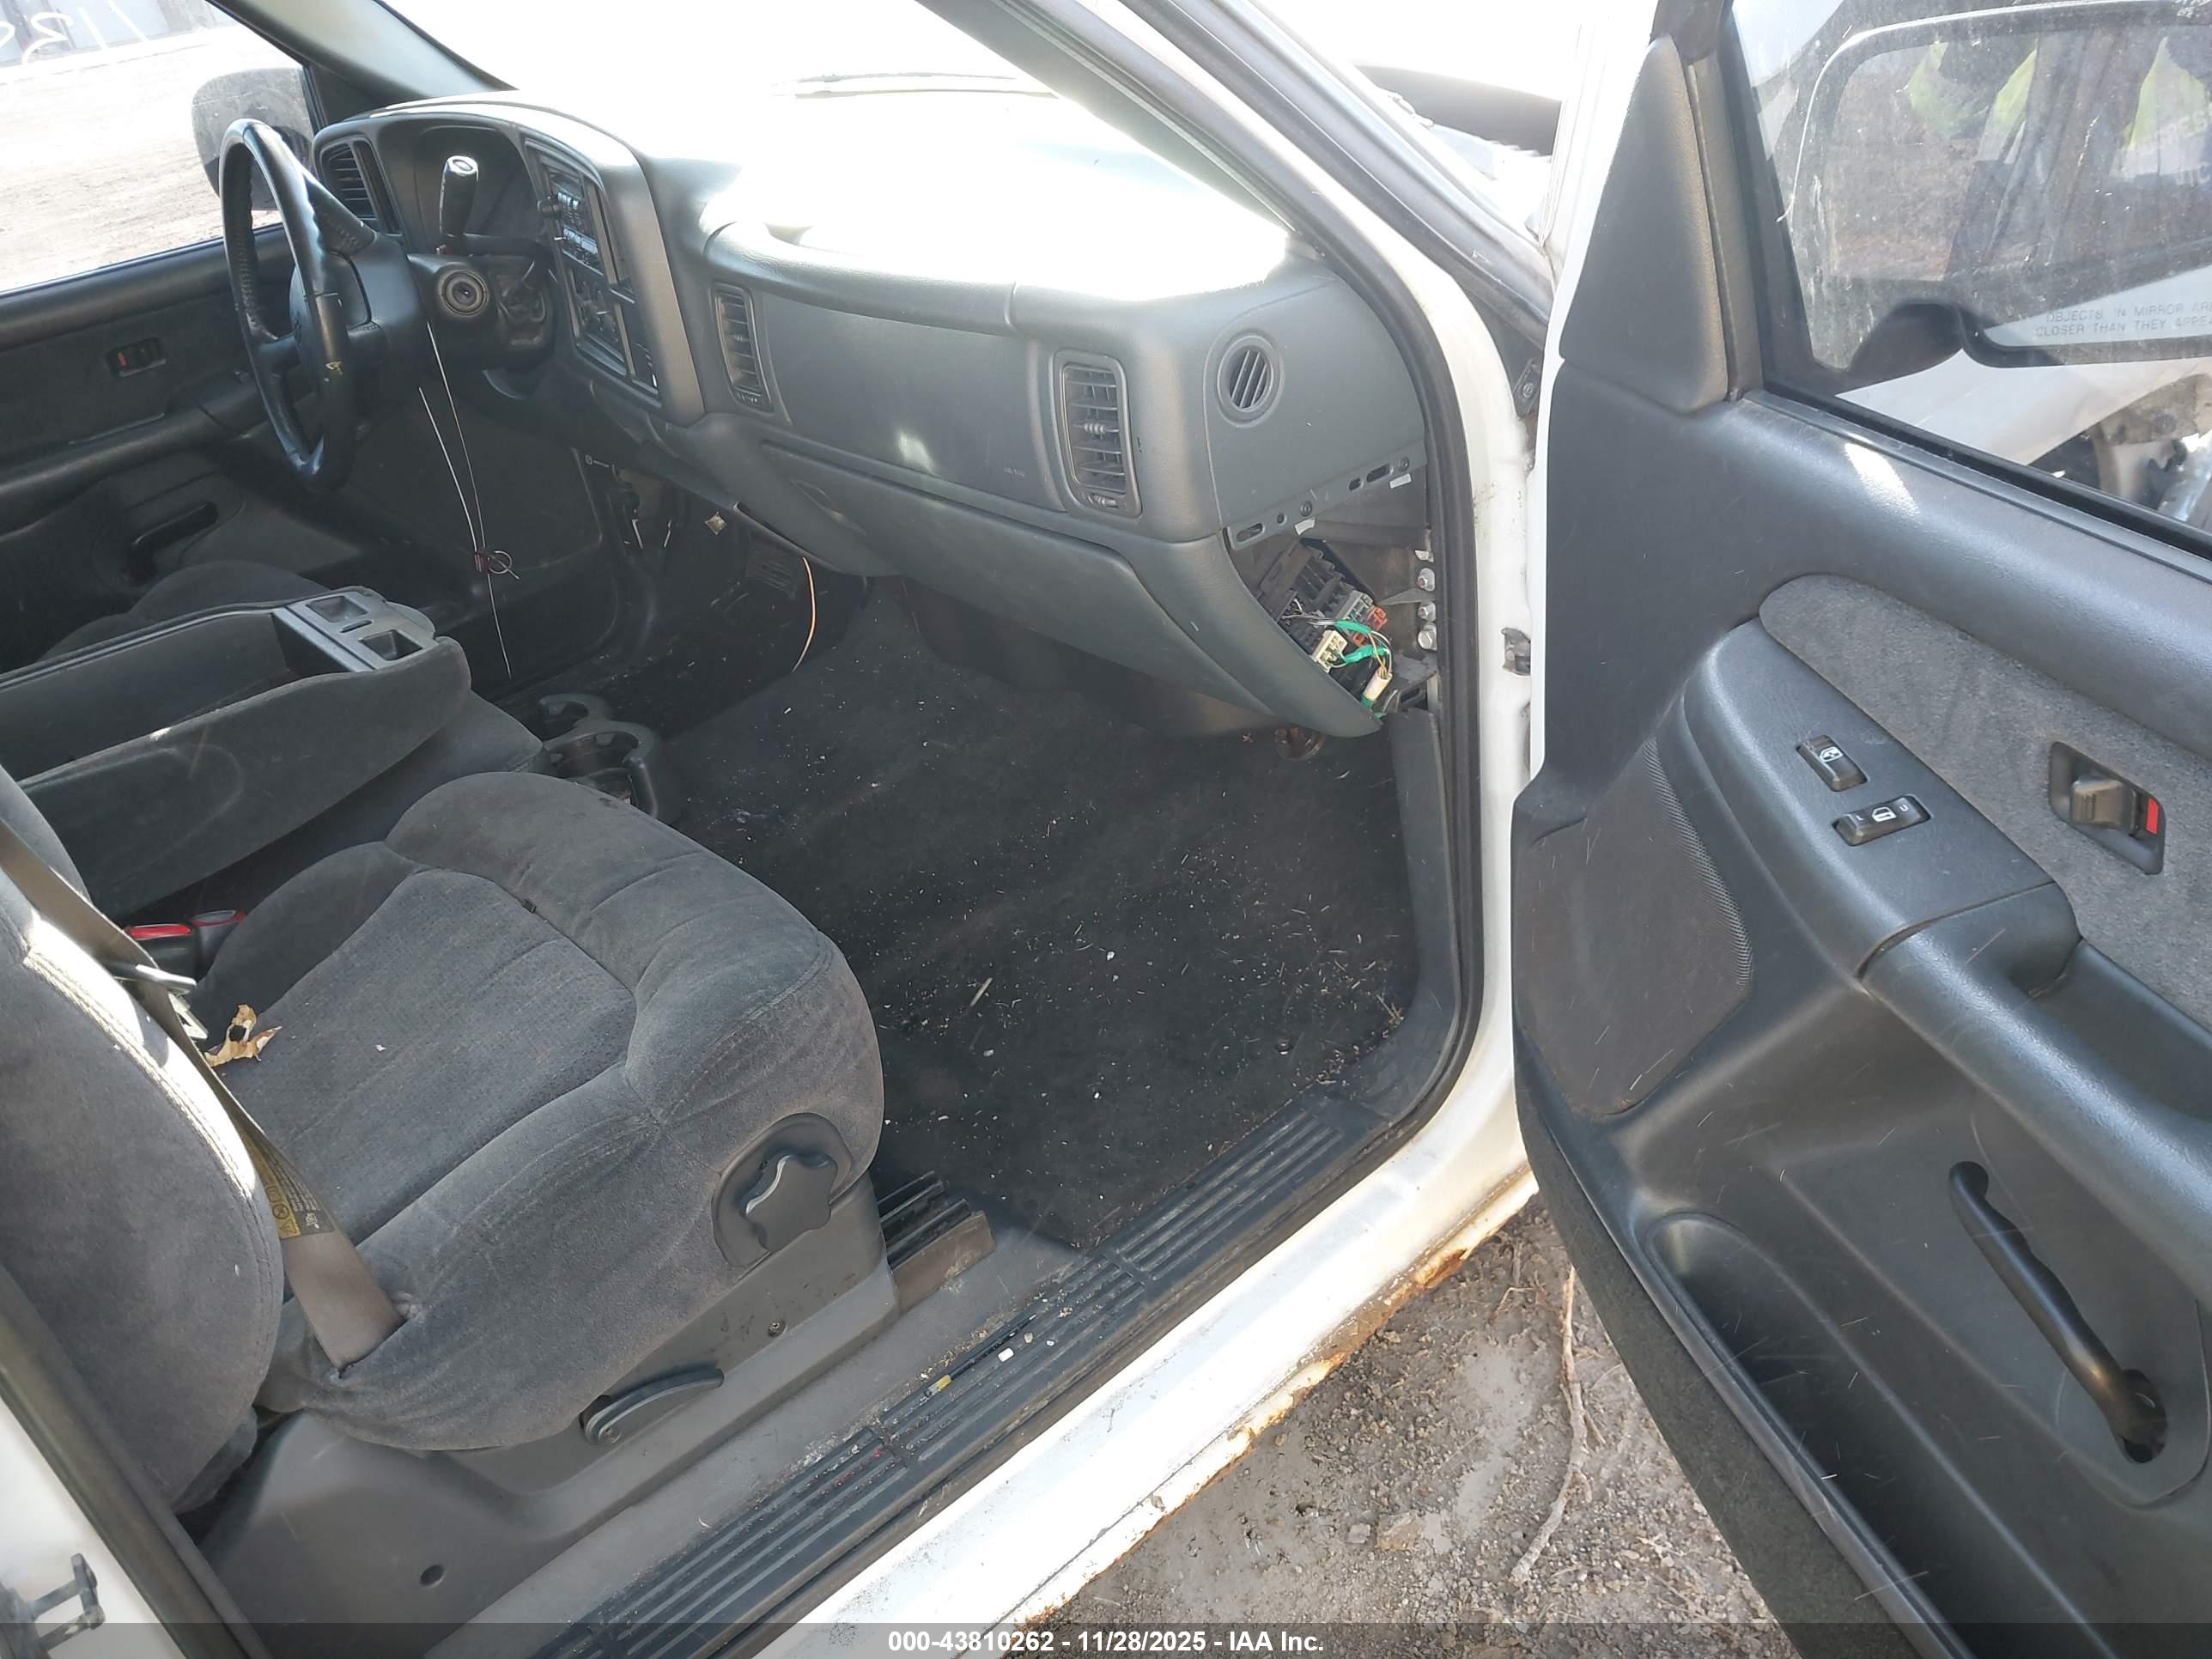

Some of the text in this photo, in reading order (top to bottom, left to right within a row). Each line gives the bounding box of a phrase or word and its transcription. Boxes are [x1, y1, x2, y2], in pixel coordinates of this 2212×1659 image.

[2047, 309, 2102, 323] OBJECTS
[2134, 302, 2185, 318] MIRROR
[2035, 324, 2085, 337] CLOSER
[2094, 321, 2125, 333] THAN
[2135, 318, 2166, 331] THEY
